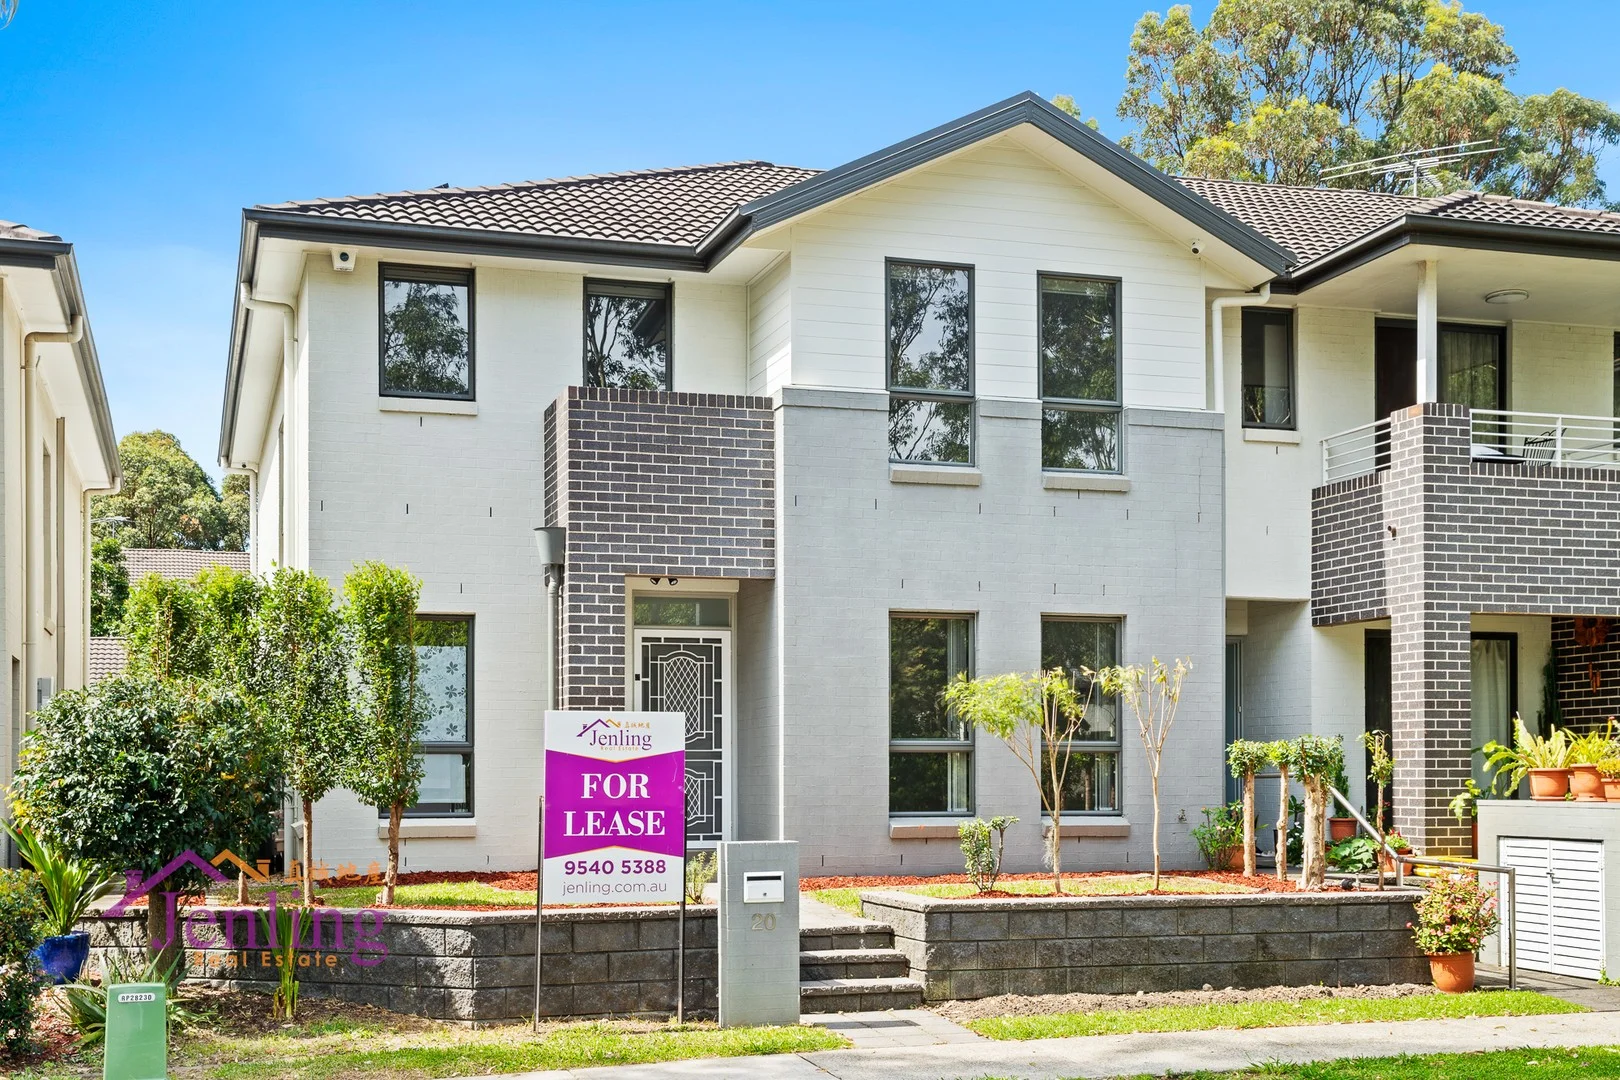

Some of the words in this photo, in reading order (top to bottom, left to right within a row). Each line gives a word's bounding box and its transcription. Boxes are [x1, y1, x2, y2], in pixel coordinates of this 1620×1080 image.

[589, 729, 652, 751] Jenling
[580, 773, 650, 799] FOR
[563, 810, 665, 837] LEASE
[564, 860, 614, 875] 9540
[621, 859, 666, 874] 5388
[562, 881, 667, 896] jenling.com.au
[751, 912, 777, 931] 20
[121, 994, 152, 1002] RP28230
